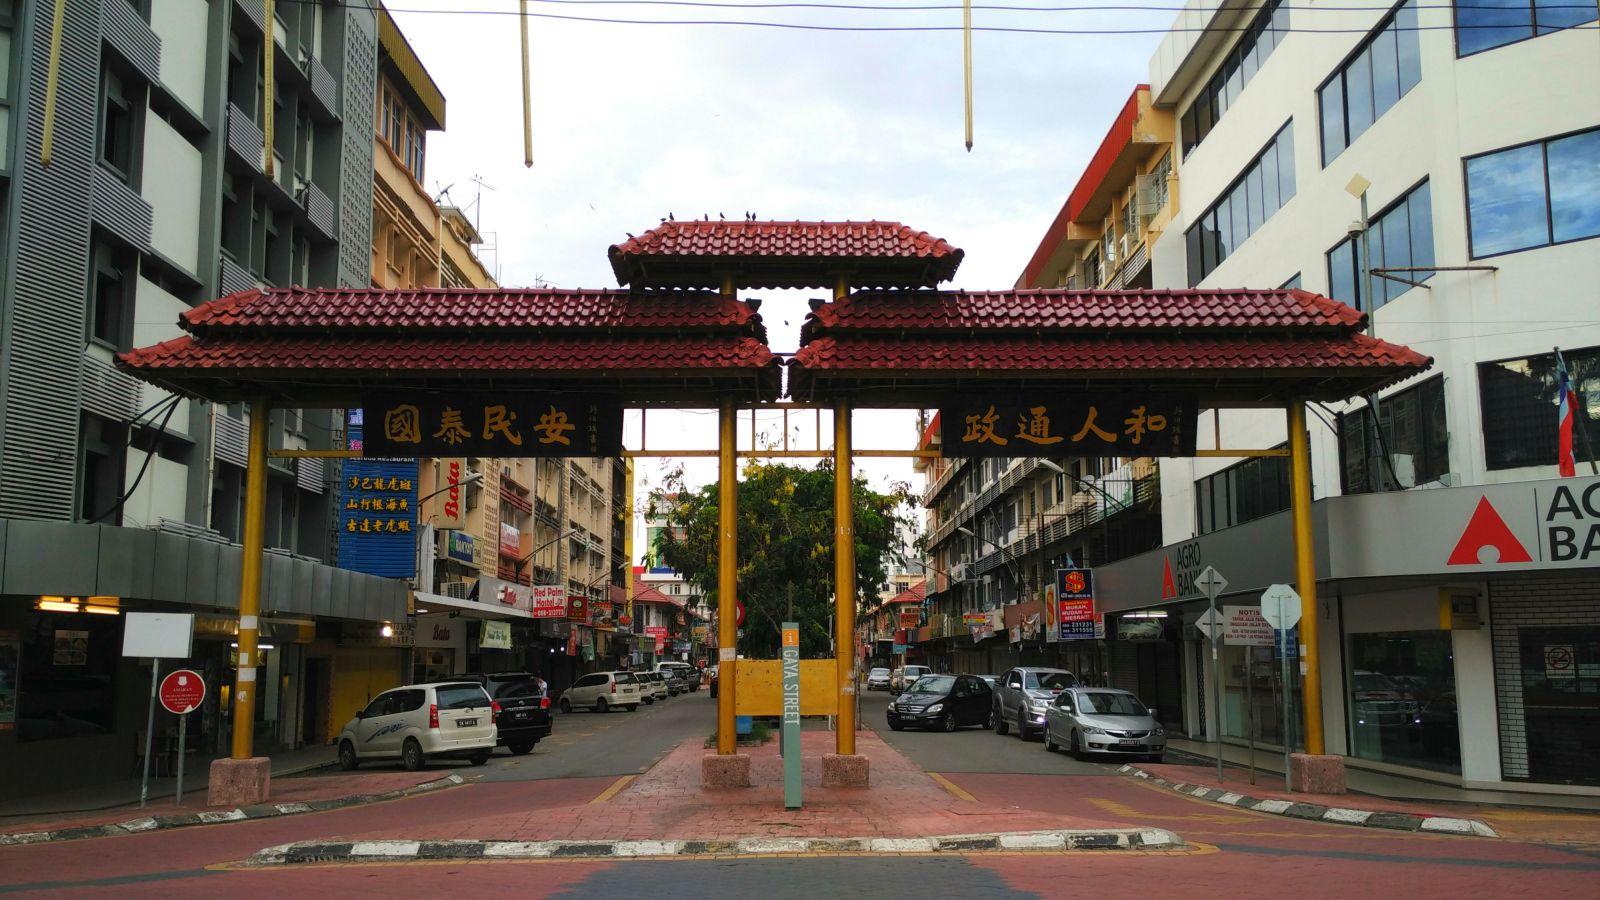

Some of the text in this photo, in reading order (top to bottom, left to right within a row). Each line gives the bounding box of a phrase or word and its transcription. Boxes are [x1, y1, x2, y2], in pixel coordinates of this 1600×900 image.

[384, 404, 576, 446] 國泰民安
[961, 404, 1167, 446] 政通人和
[444, 461, 460, 520] Bata
[1177, 541, 1201, 573] AGRO
[534, 587, 564, 597] Red Palm
[432, 623, 451, 641] Bata
[783, 650, 800, 726] GAYA STREET
